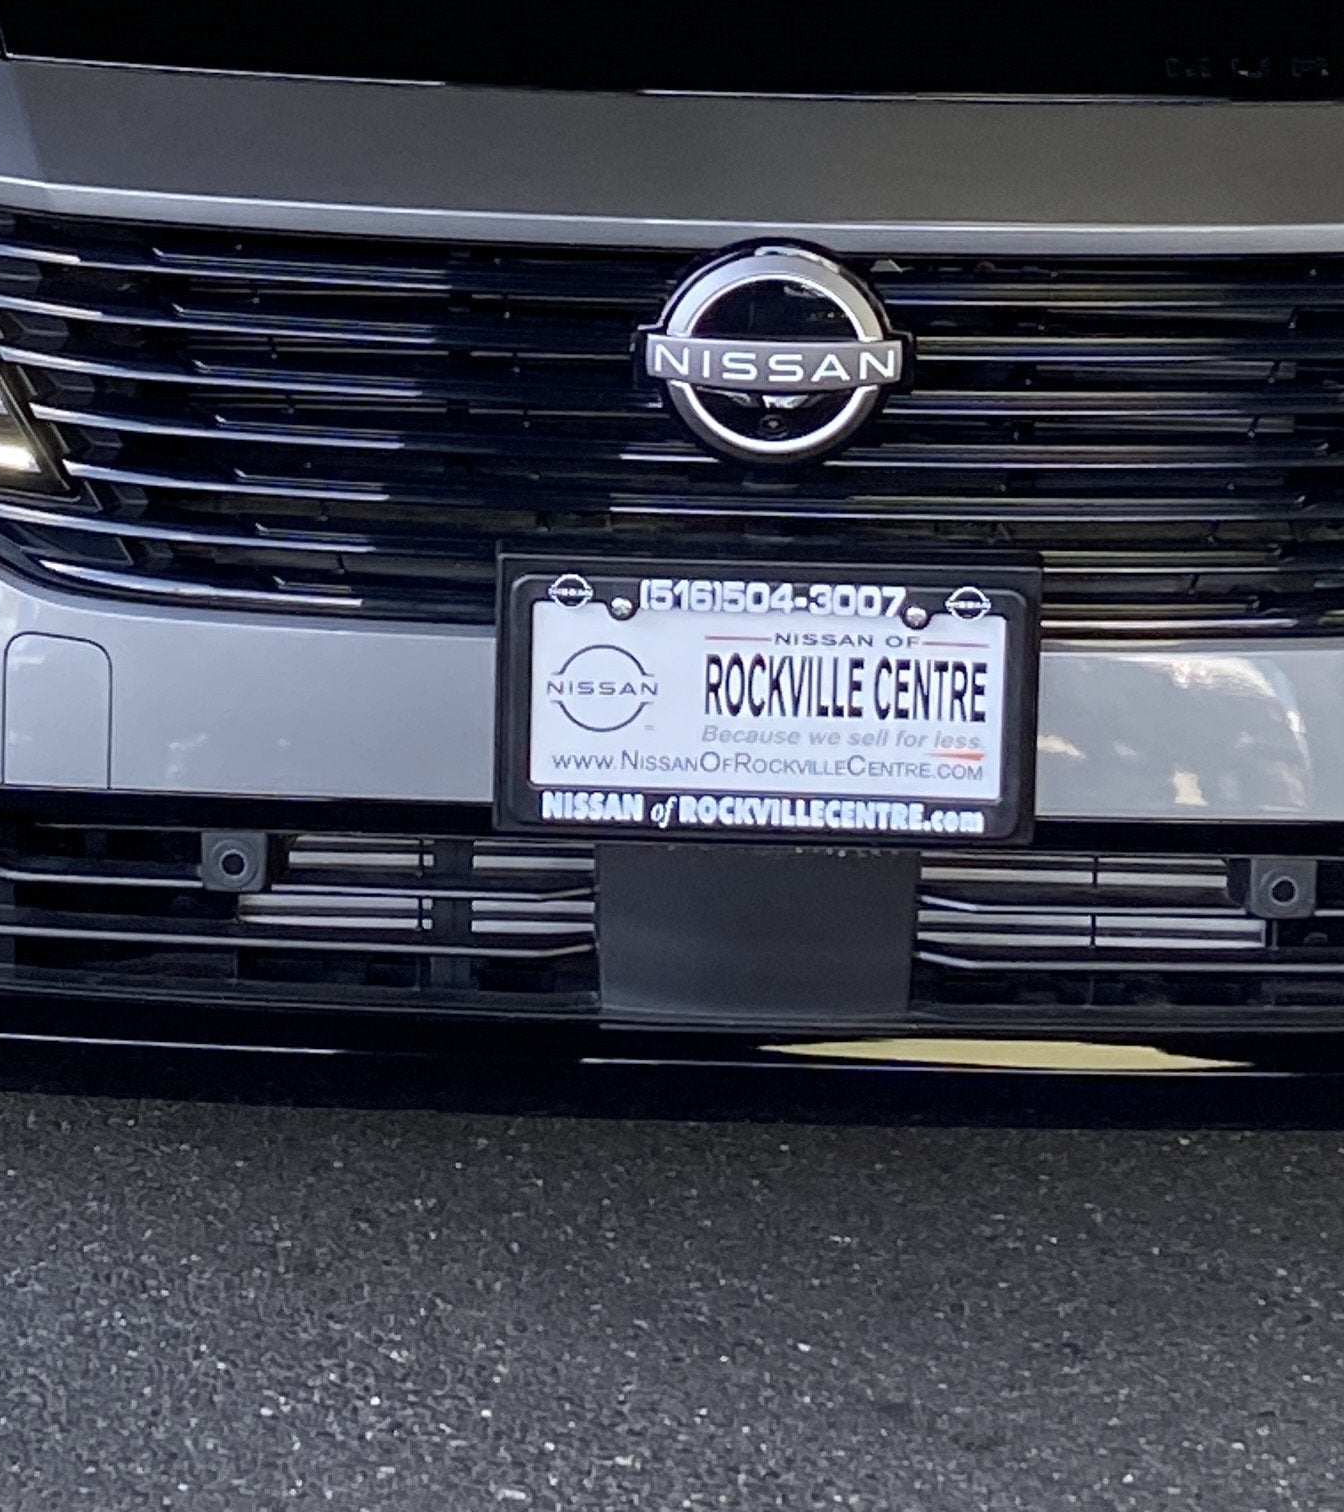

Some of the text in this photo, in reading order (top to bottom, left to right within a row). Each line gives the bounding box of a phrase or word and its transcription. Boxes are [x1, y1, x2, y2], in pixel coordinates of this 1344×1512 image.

[656, 343, 895, 383] NISSAN
[640, 578, 906, 617] (516)504-3007
[774, 632, 920, 649] NISSAN OF
[546, 680, 658, 696] NISSAN
[704, 653, 986, 723] ROCKVILLE CENTRE
[702, 725, 802, 745] Because
[809, 731, 841, 745] we
[847, 728, 890, 747] sell
[895, 729, 928, 748] for
[542, 790, 985, 833] NISSAN of ROCKVILLECENTRE.com
